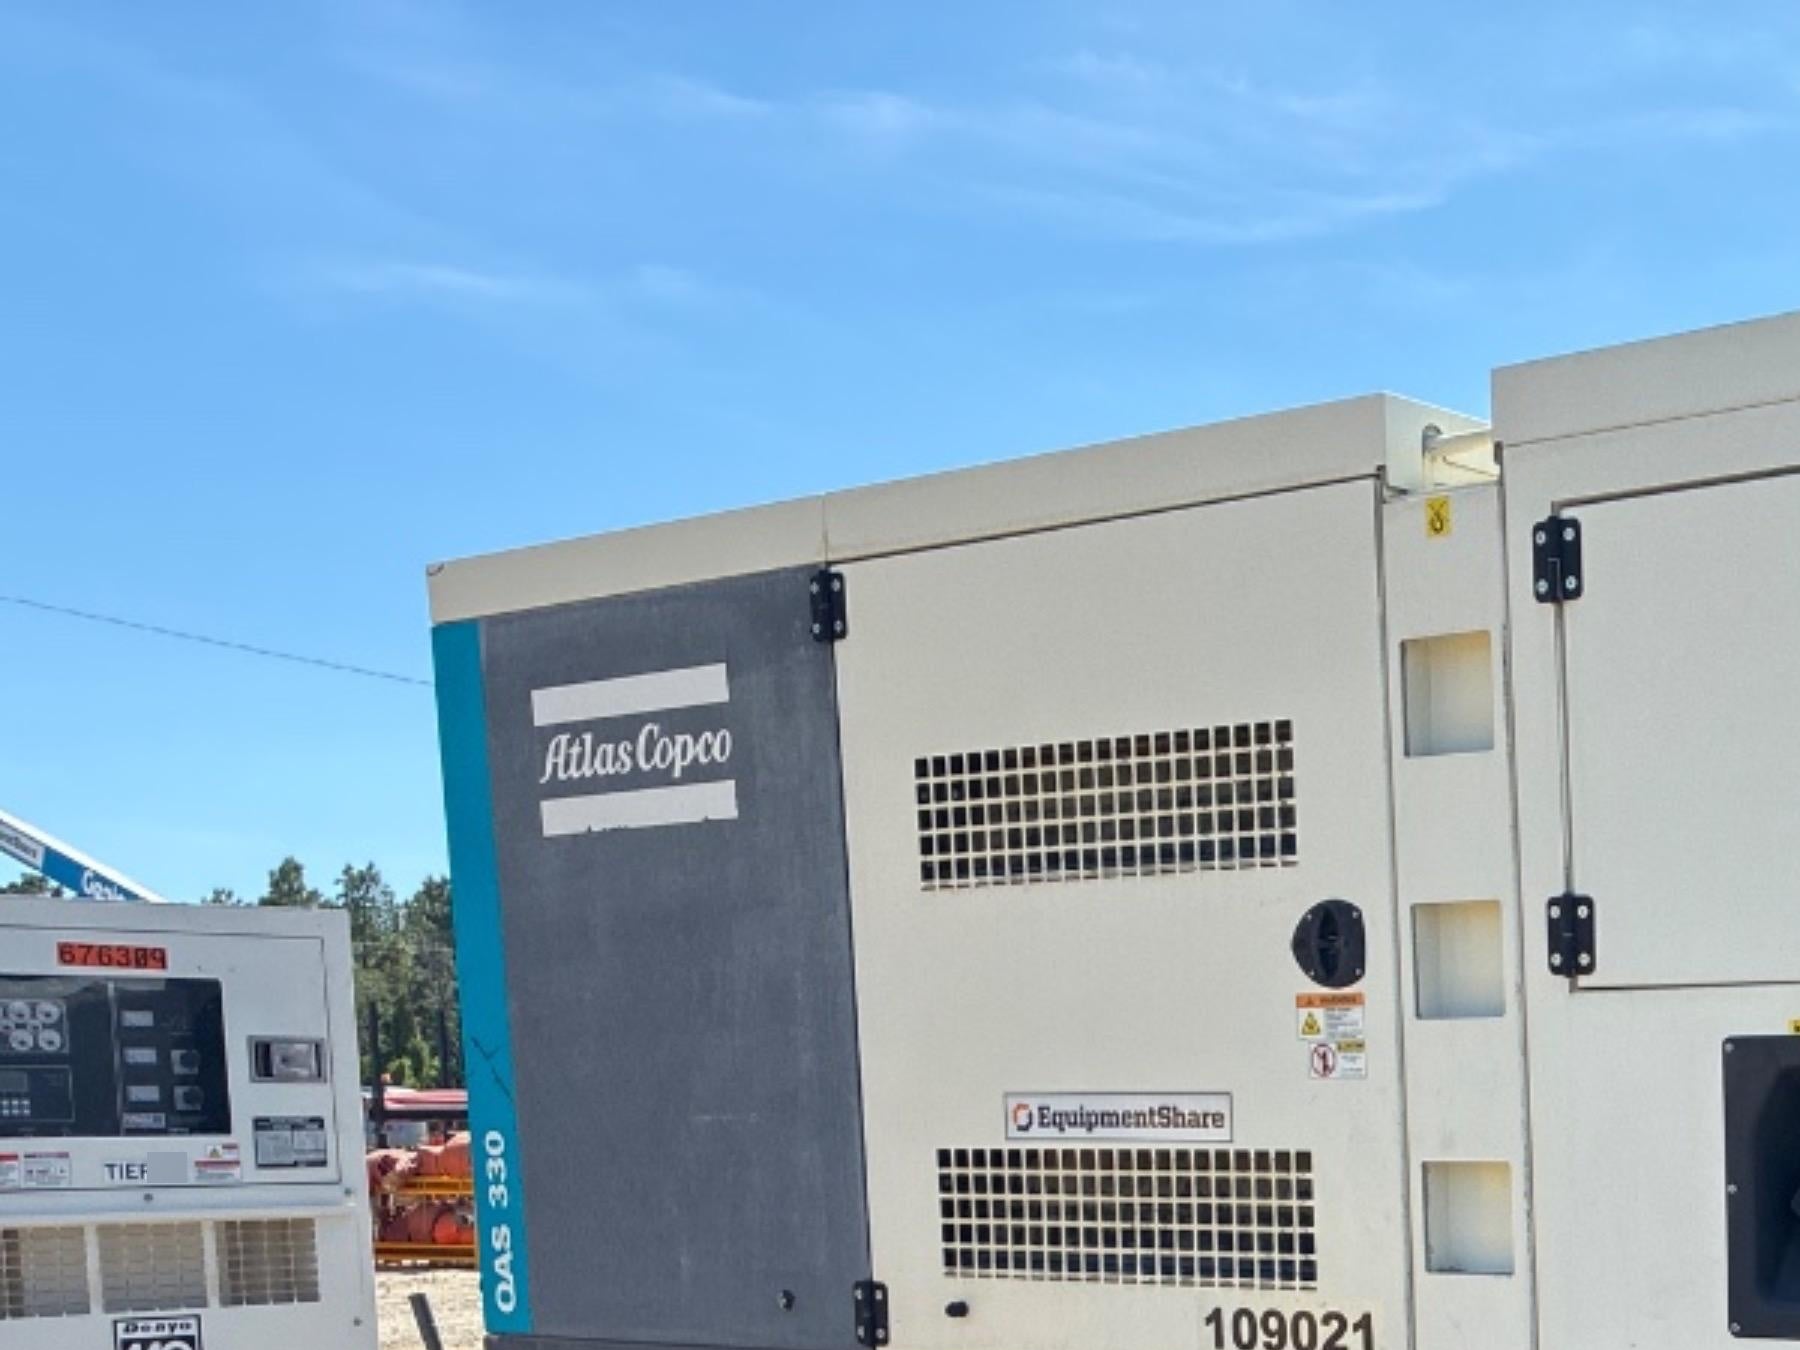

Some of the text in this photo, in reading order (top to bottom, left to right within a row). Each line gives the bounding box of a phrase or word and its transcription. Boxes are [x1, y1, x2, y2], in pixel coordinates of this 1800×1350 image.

[539, 722, 732, 783] Atlas Copco
[1037, 1105, 1225, 1133] EquipmentShare
[484, 1129, 517, 1314] QAS 330
